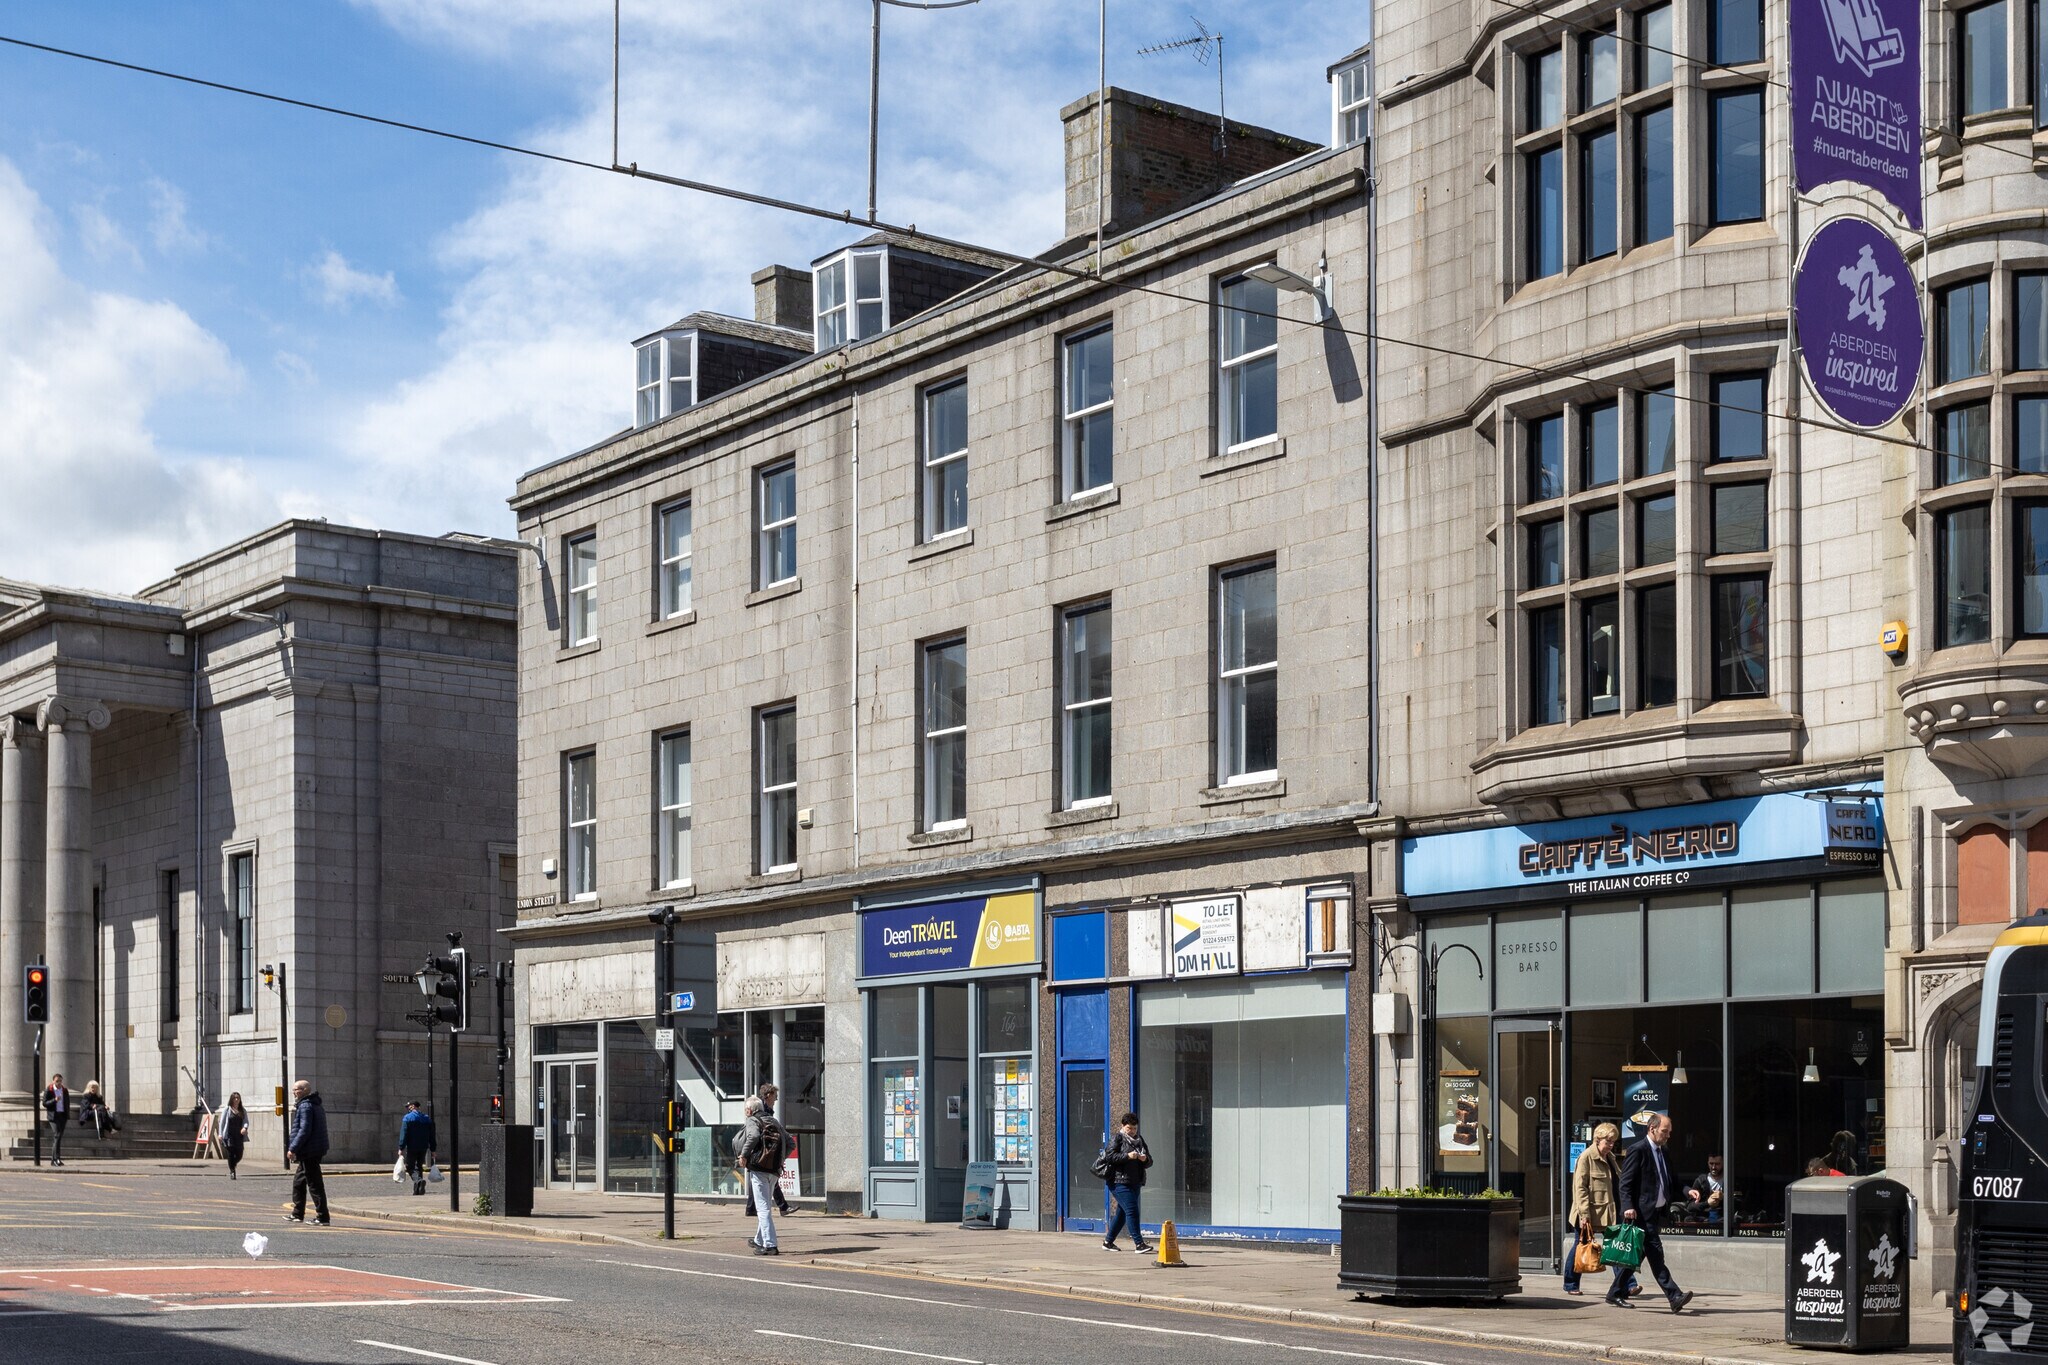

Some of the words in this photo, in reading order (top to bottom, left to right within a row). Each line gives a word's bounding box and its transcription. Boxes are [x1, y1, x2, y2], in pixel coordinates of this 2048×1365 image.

[1816, 75, 1888, 119] NUART
[1810, 101, 1910, 154] ABERDEEN
[1813, 135, 1909, 179] #nuartaberdeen
[1828, 331, 1897, 362] ABERDEEN
[1825, 348, 1898, 393] inspired
[1824, 385, 1847, 397] BUSINESS
[1846, 391, 1879, 405] IMPROVEMENT
[1878, 399, 1897, 409] DISTRICT
[1884, 631, 1897, 643] ADT
[1829, 824, 1877, 841] NERO
[1632, 821, 1738, 861] NERO
[1829, 851, 1863, 861] ESPRESSO
[1863, 852, 1877, 861] BAR
[1568, 881, 1587, 894] THE
[1589, 877, 1630, 892] ITALIAN
[1633, 873, 1672, 888] COFFEE
[533, 895, 555, 907] STREET
[1203, 905, 1215, 918] TO
[1217, 903, 1235, 917] LET
[1011, 924, 1031, 937] ABTA
[1203, 936, 1217, 944] 01224
[1217, 935, 1235, 943] 594172
[1501, 940, 1558, 955] ESPRESSO
[926, 947, 939, 955] Travel
[939, 946, 953, 955] Agent
[1177, 954, 1199, 973] DM
[1200, 951, 1236, 972] HALL
[1519, 961, 1540, 972] BAR
[383, 974, 409, 983] SOUTH
[1973, 1176, 2023, 1198] 67087
[1610, 1239, 1632, 1253] M&S
[1796, 1287, 1843, 1298] ABERDEEN
[1863, 1284, 1900, 1293] ABERDEEN
[1795, 1296, 1845, 1316] inspired
[1862, 1292, 1901, 1312] inspired
